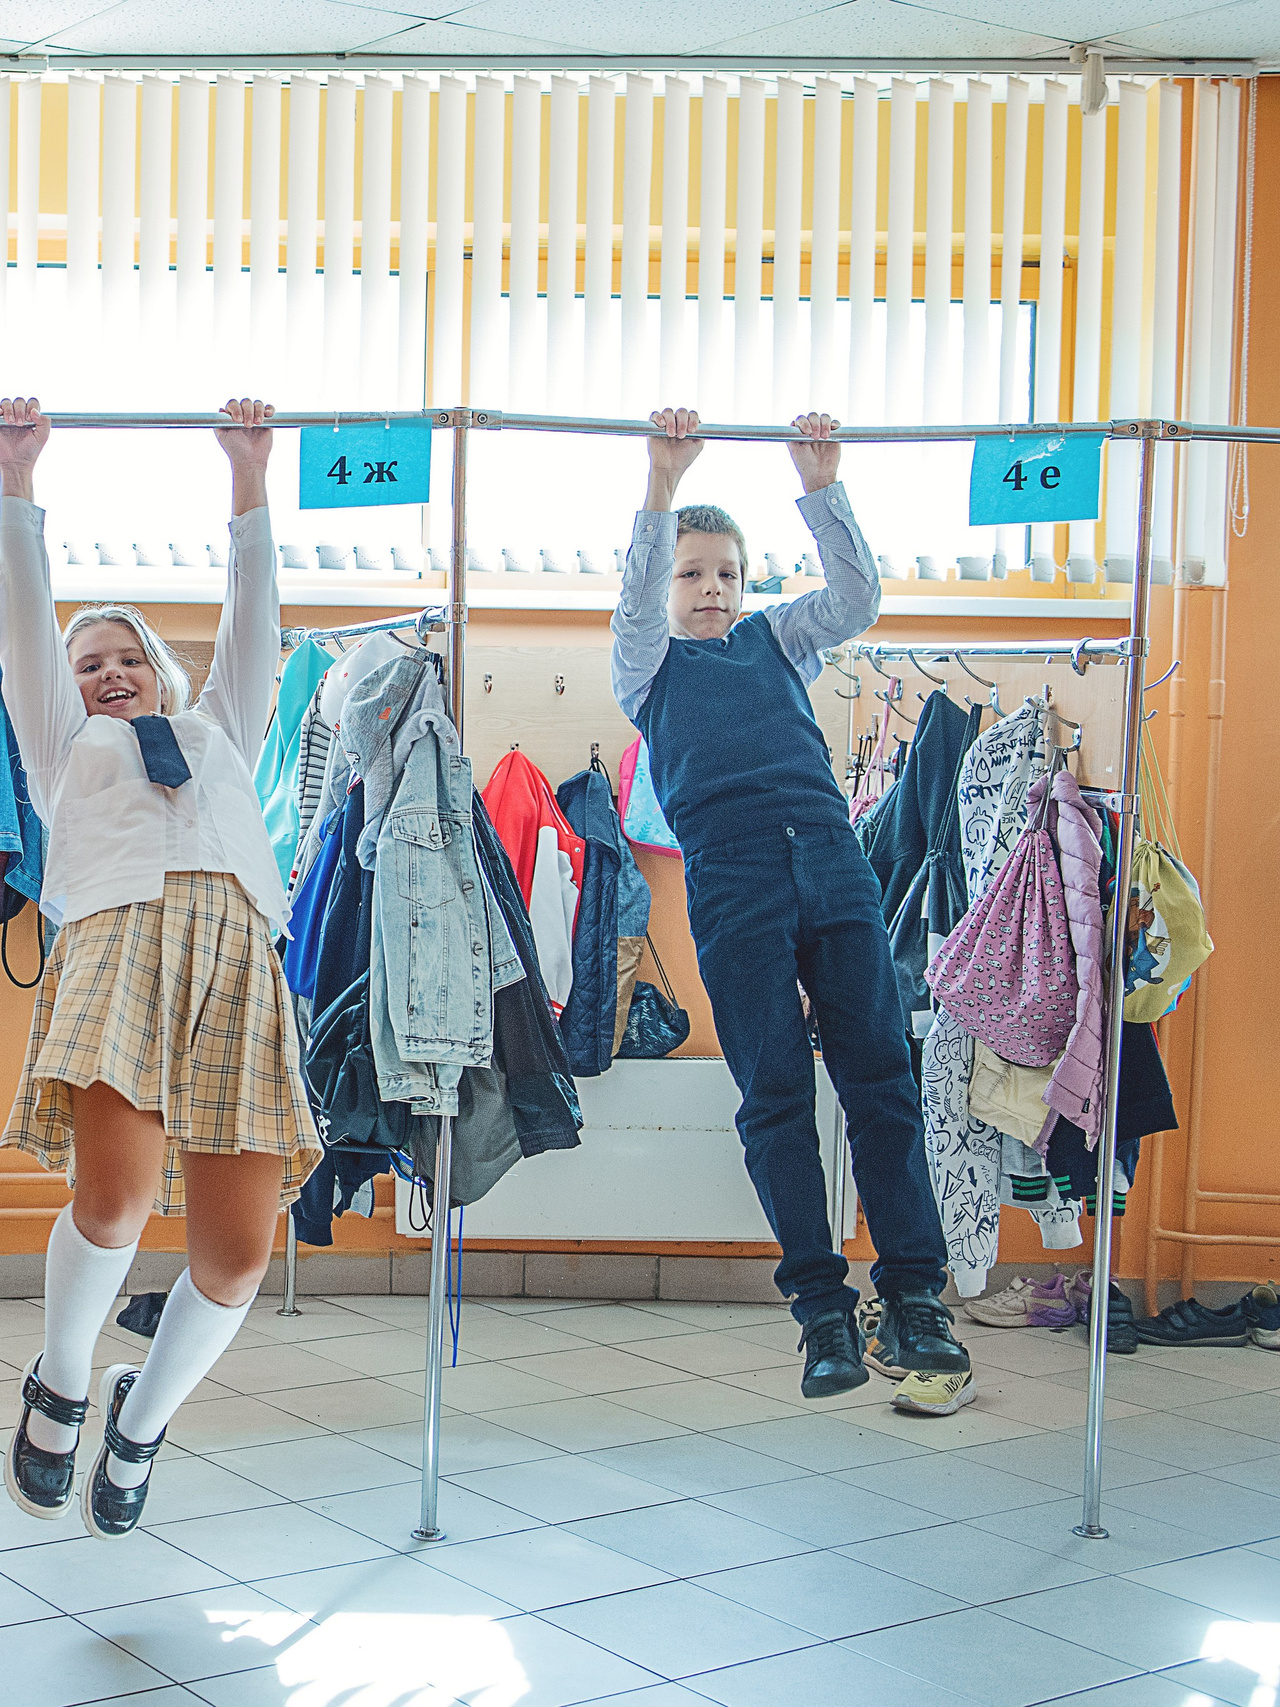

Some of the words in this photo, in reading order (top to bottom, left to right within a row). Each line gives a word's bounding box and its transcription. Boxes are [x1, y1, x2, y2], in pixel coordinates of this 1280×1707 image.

[327, 456, 352, 485] 4
[363, 461, 398, 483] ж
[1002, 460, 1027, 490] 4
[1040, 466, 1060, 489] е
